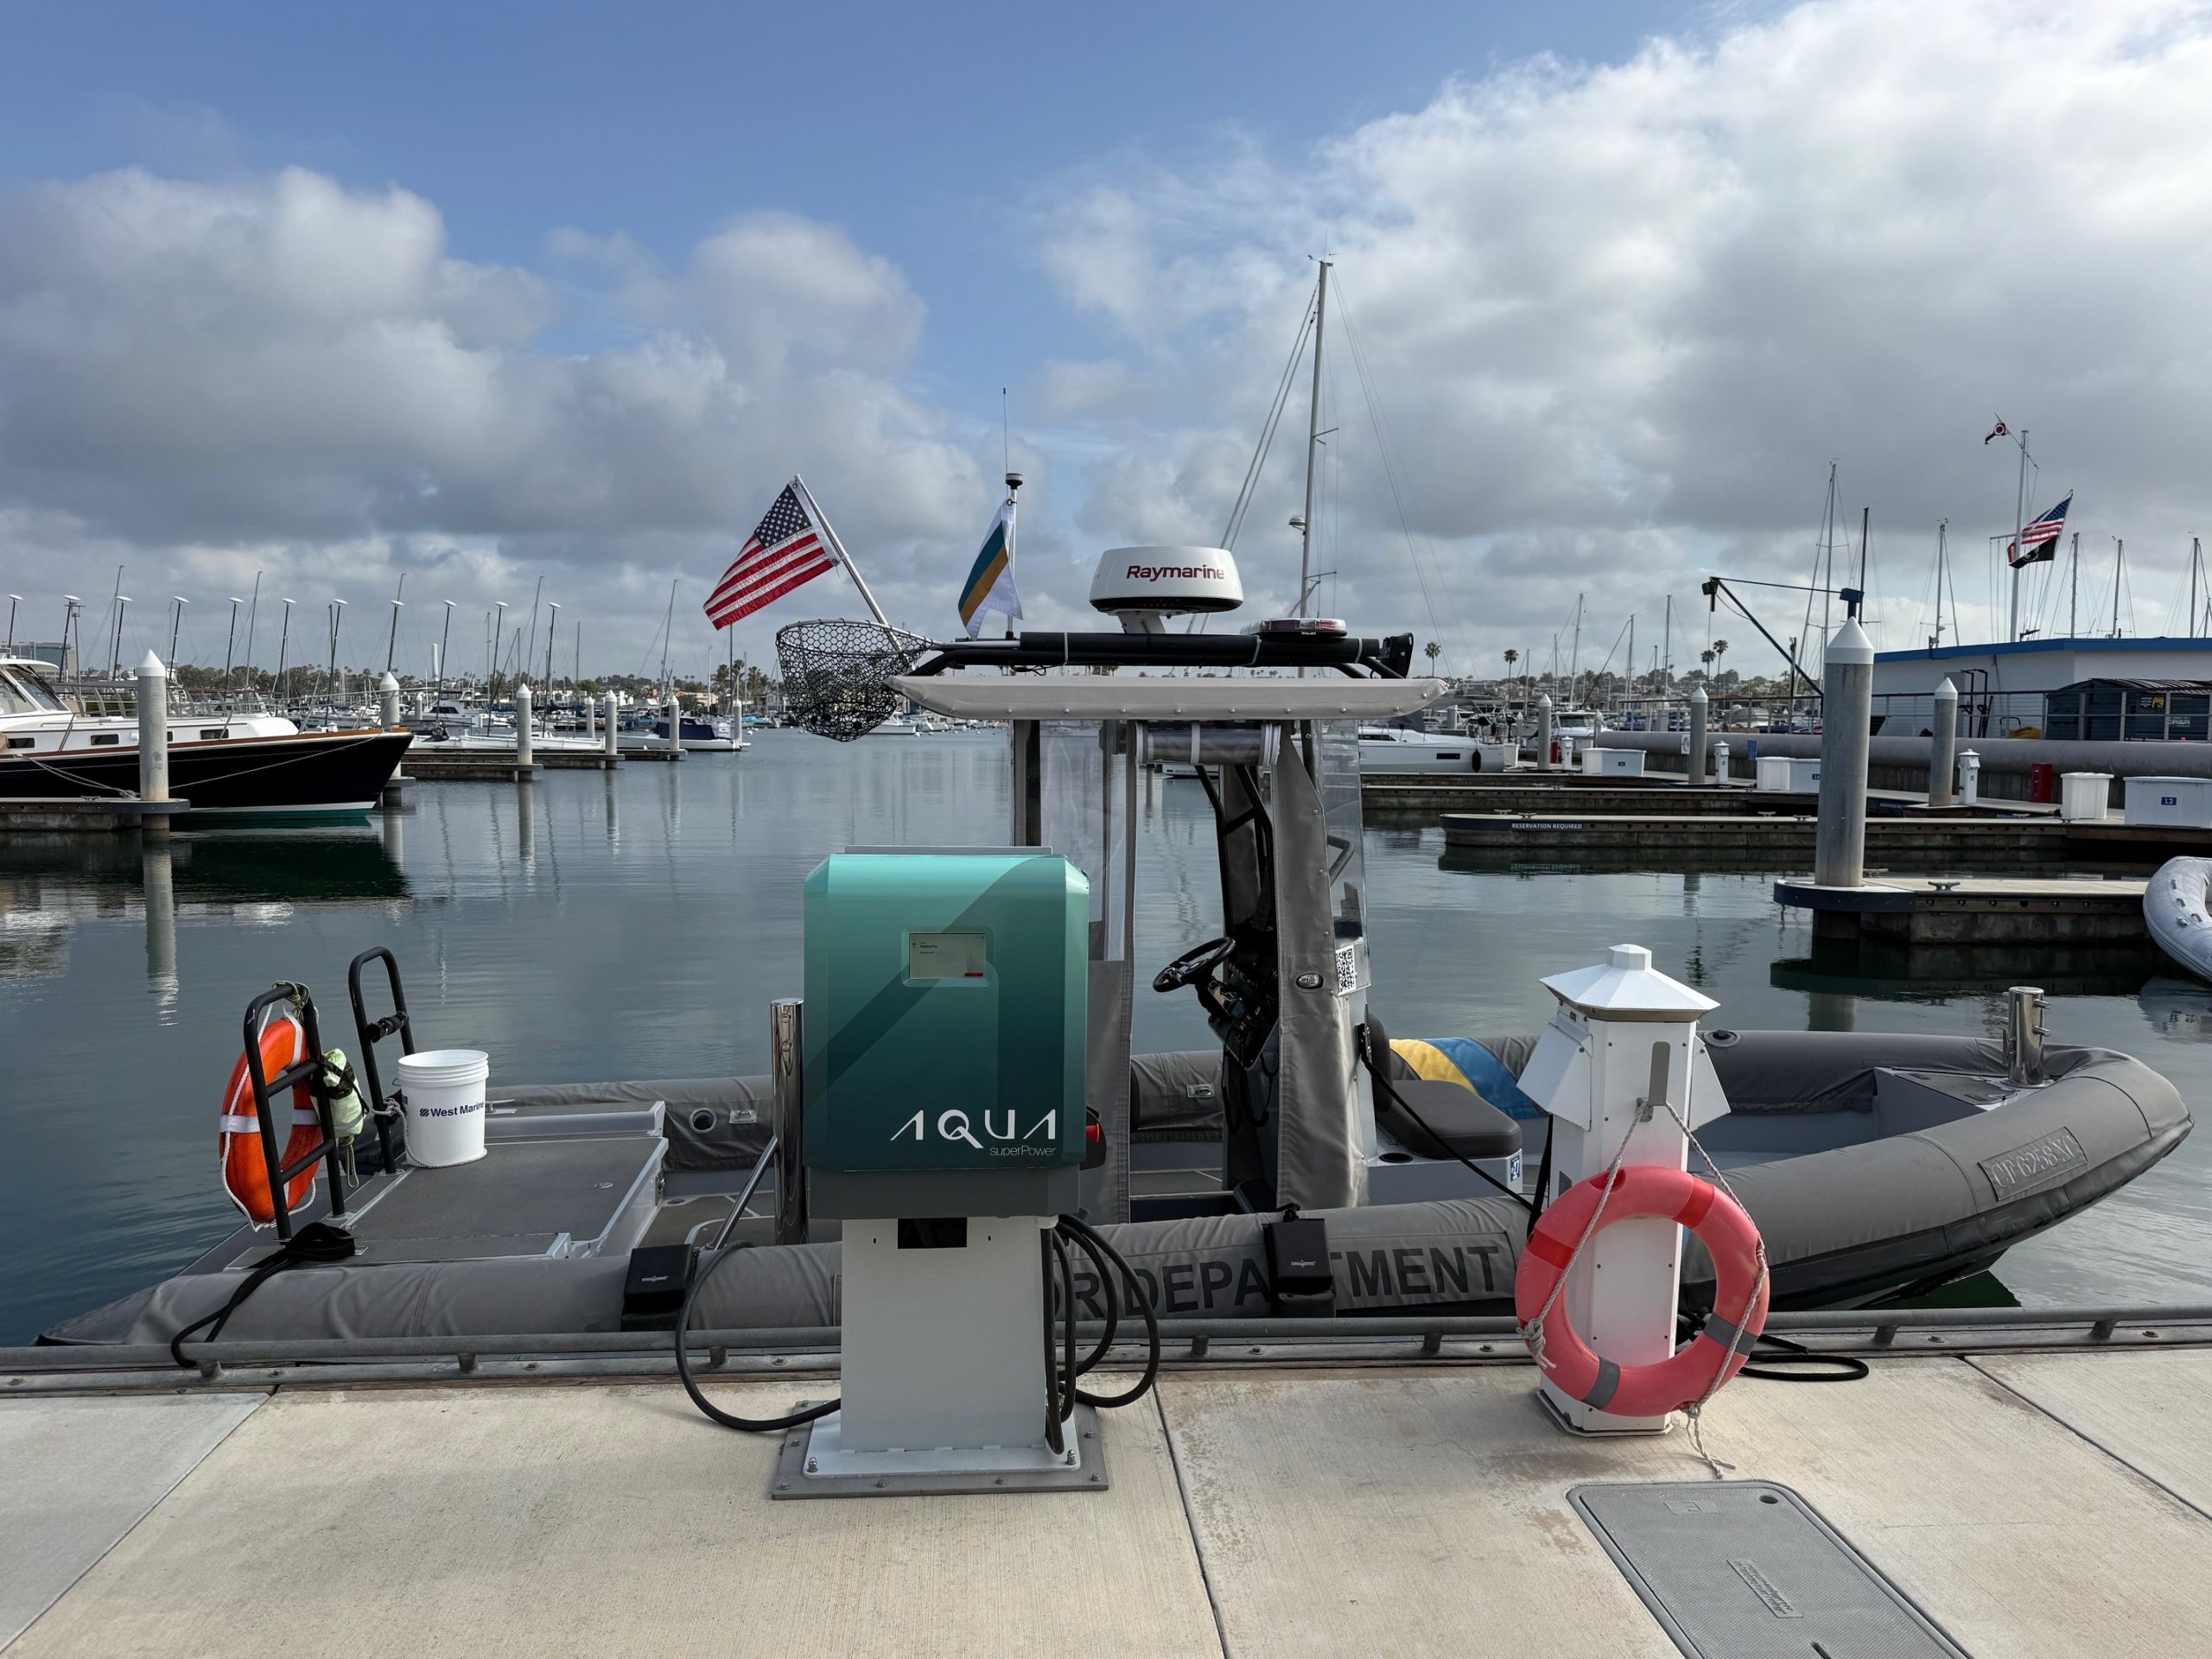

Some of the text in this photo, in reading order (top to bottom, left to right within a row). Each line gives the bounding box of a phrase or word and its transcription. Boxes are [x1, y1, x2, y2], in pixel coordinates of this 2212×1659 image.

[1126, 564, 1225, 582] Raymarine
[430, 1107, 458, 1117] West
[890, 1109, 1056, 1149] AQUA
[989, 1145, 1056, 1159] superPower
[2016, 1145, 2058, 1178] 6258
[1123, 1245, 1500, 1317] DEPAMENT
